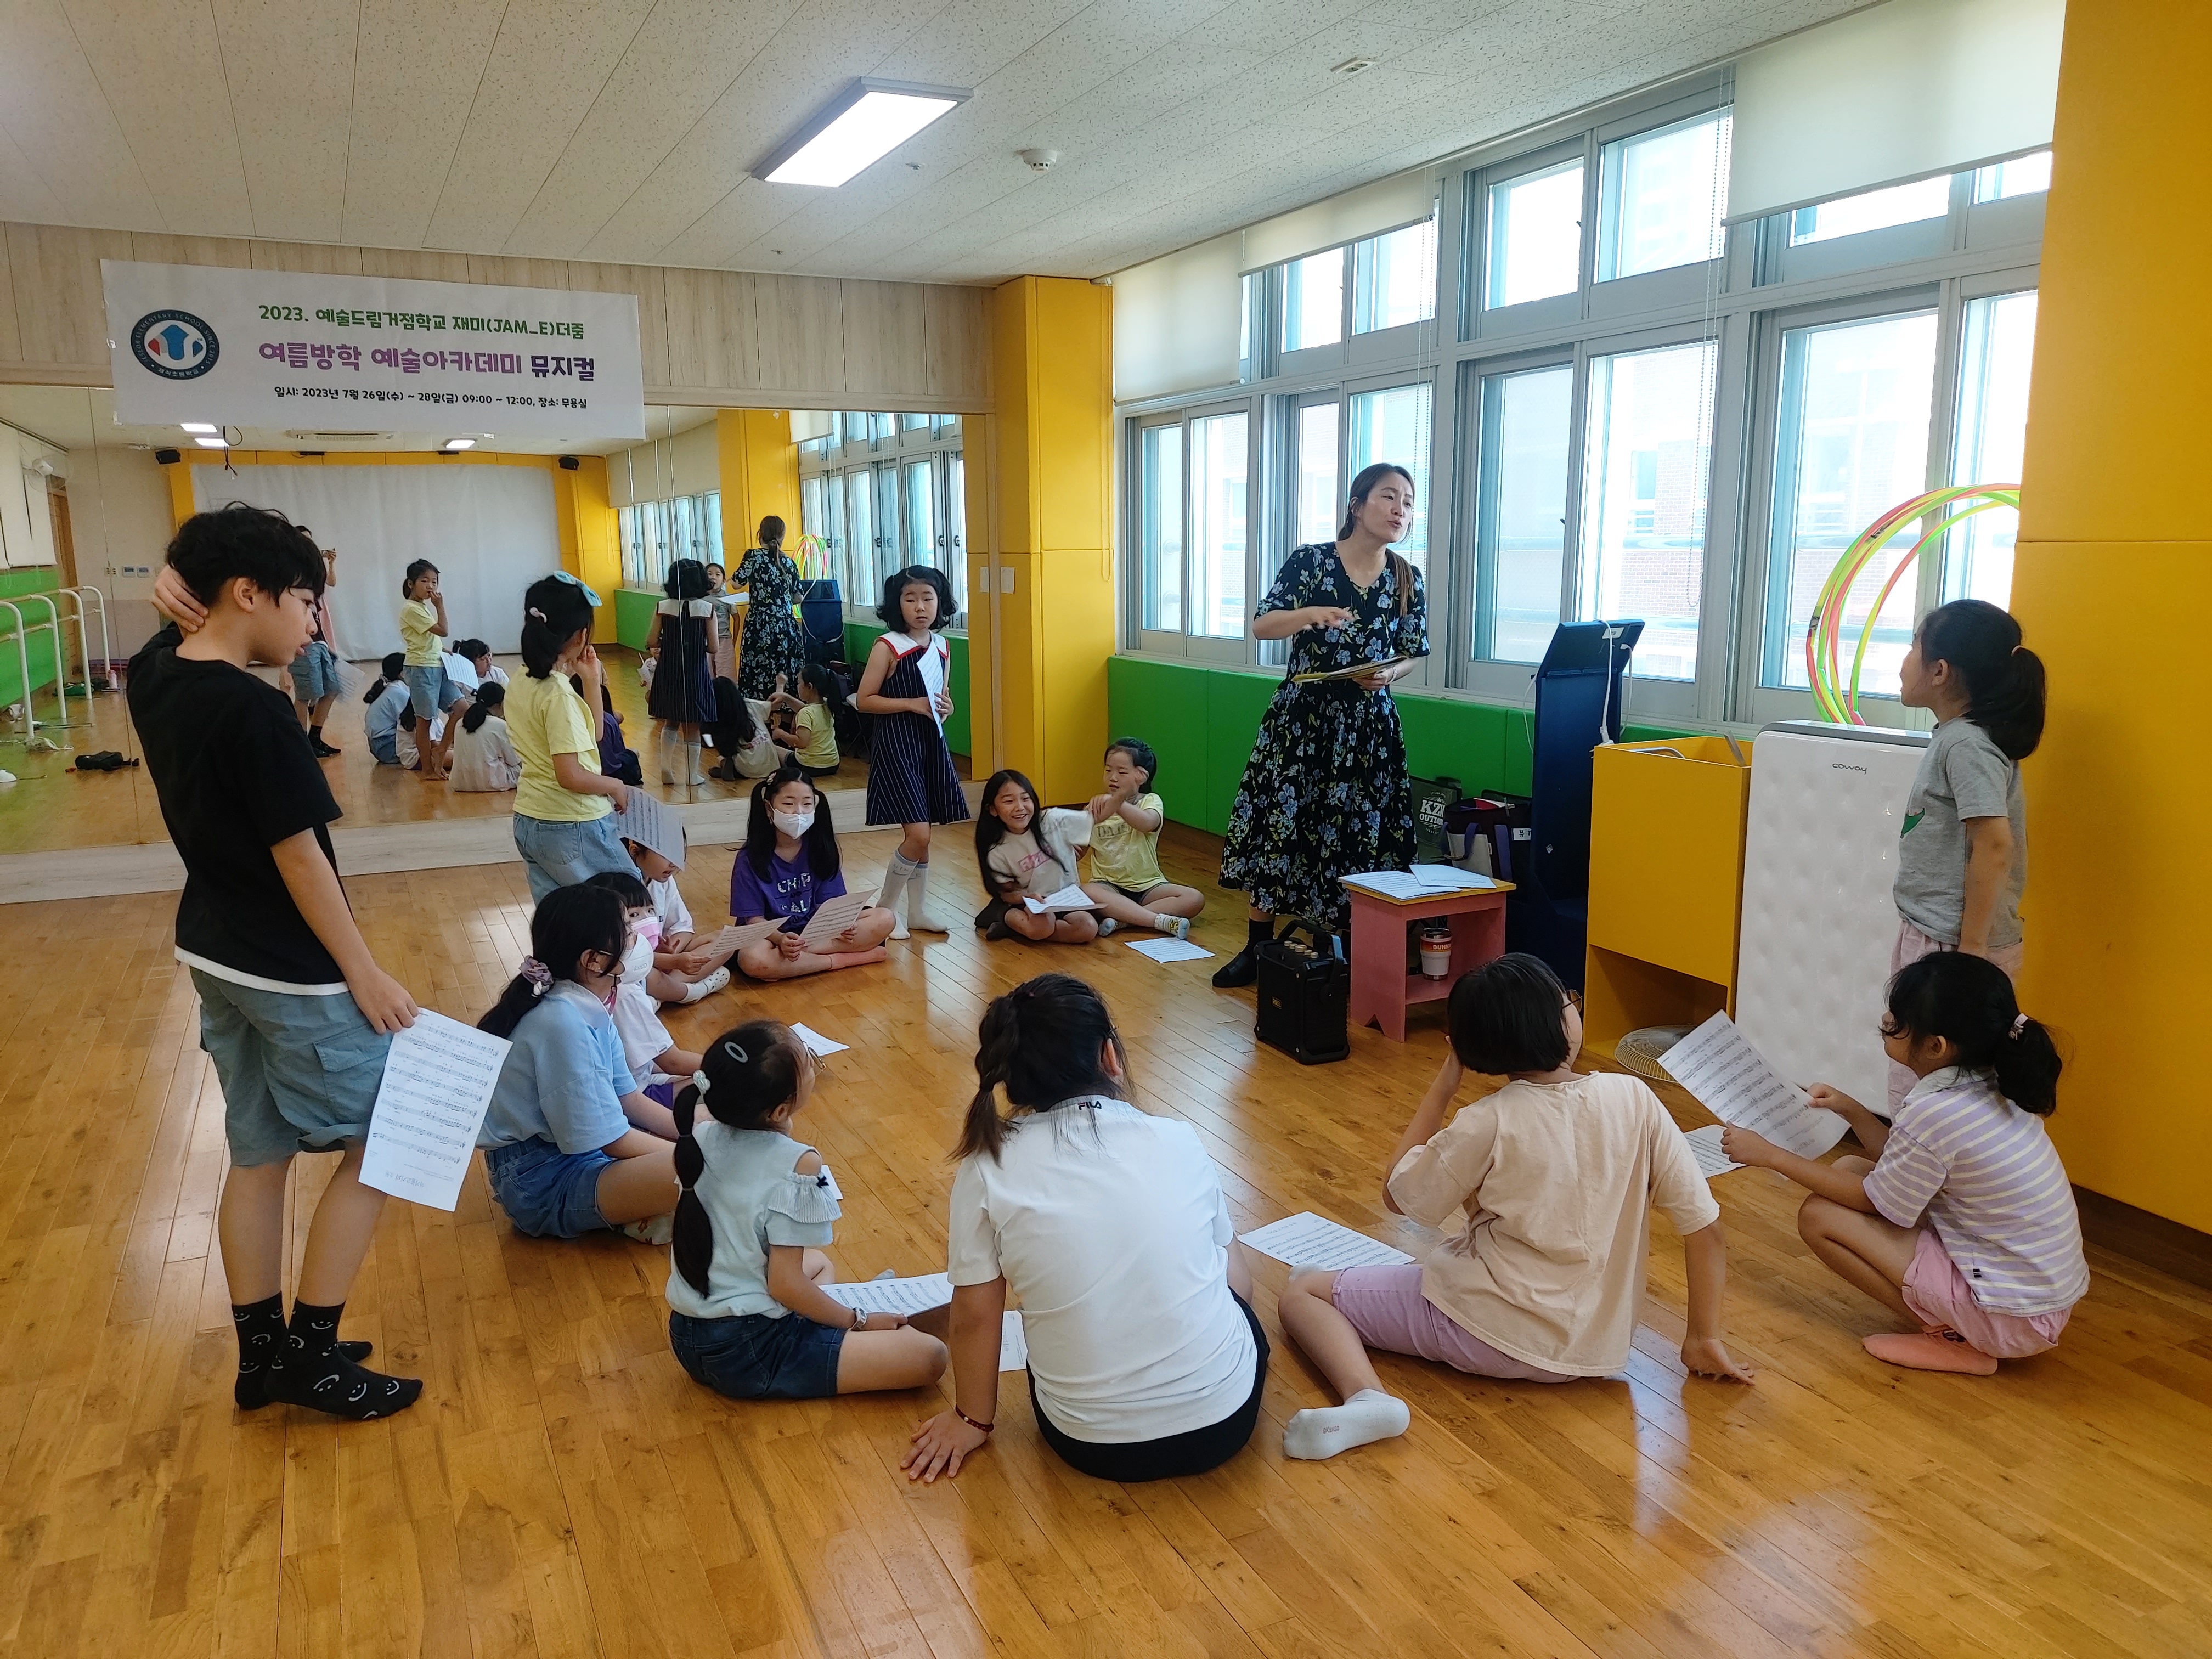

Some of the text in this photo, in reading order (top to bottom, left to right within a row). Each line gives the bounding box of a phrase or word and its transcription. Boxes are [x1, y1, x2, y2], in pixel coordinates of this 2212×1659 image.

[175, 313, 204, 330] SCHOOL
[258, 305, 584, 340] 2023. 예술드림거점학교 재미(JAM_E)더줌
[259, 342, 595, 381] 여름방학 예술아카데미 뮤지컬
[274, 386, 298, 396] 일시:
[303, 388, 338, 399] 2023년
[342, 390, 359, 400] 7월
[362, 390, 404, 402] 26일(수)
[418, 393, 459, 404] 28일(금)
[462, 394, 492, 404] 09:00
[505, 396, 535, 407] 12:00,
[538, 397, 559, 407] 장소:
[562, 398, 587, 409] 무용실
[1832, 763, 1867, 774] coway
[777, 872, 811, 893] CHIP
[1077, 1101, 1102, 1110] FILA
